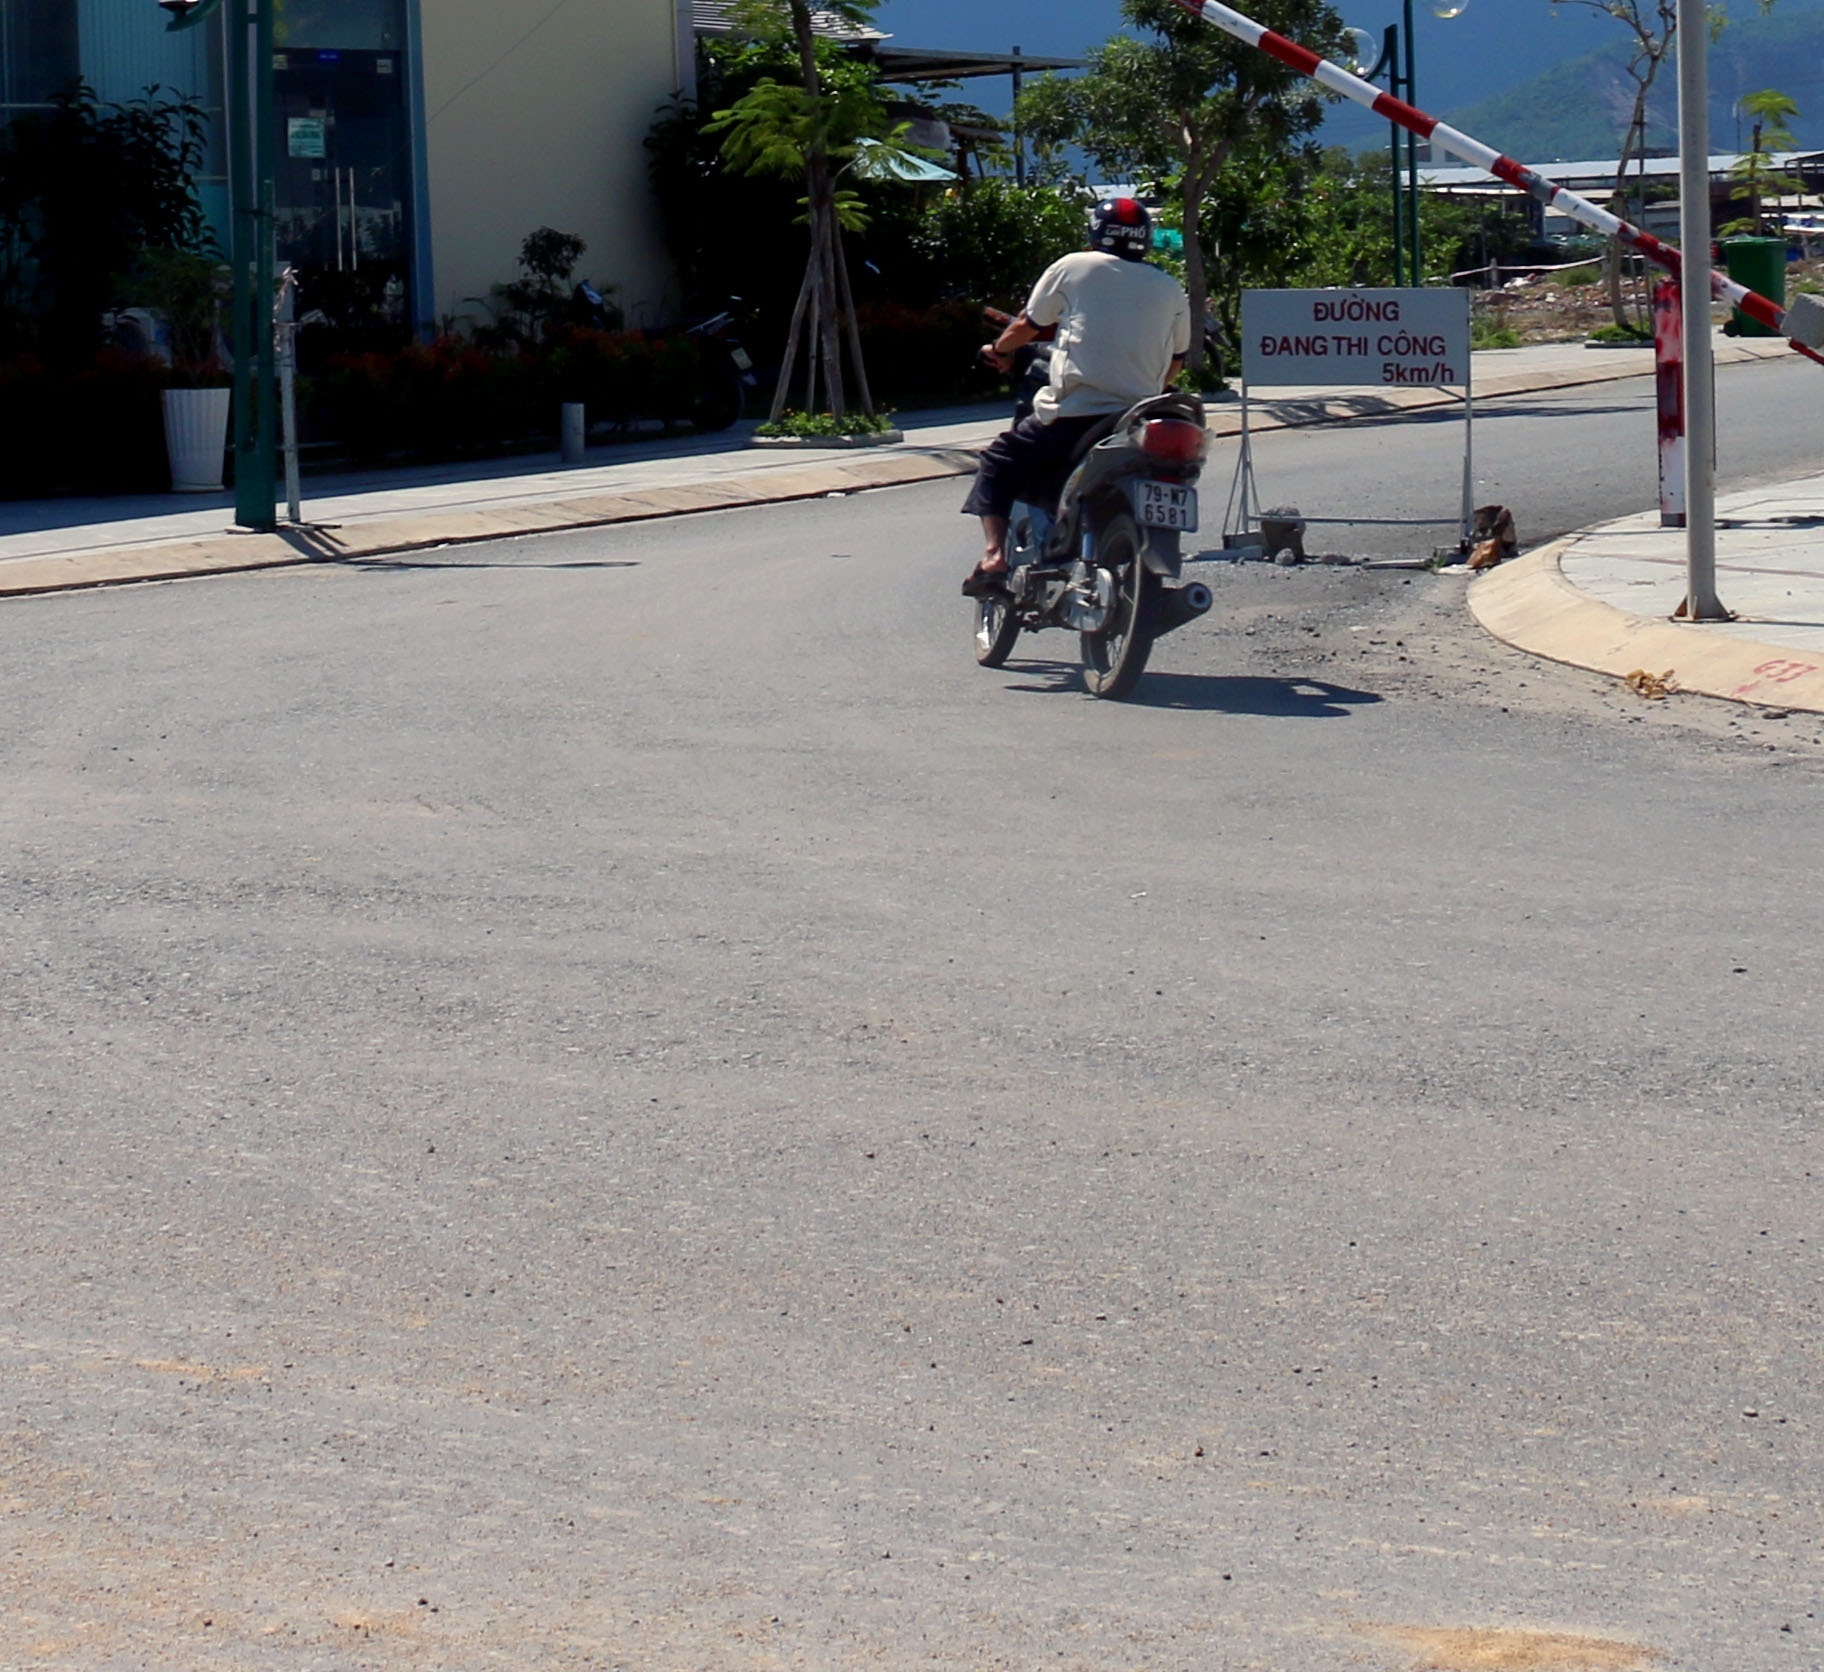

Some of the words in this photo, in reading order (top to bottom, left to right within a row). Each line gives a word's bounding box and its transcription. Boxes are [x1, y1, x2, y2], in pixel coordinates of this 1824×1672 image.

[1313, 293, 1400, 322] ĐƯỜNG
[1260, 335, 1328, 357] ĐANG
[1332, 335, 1369, 357] THI
[1377, 329, 1447, 357] CÔNG
[1382, 362, 1454, 384] 5km/h
[1145, 503, 1187, 527] 6581
